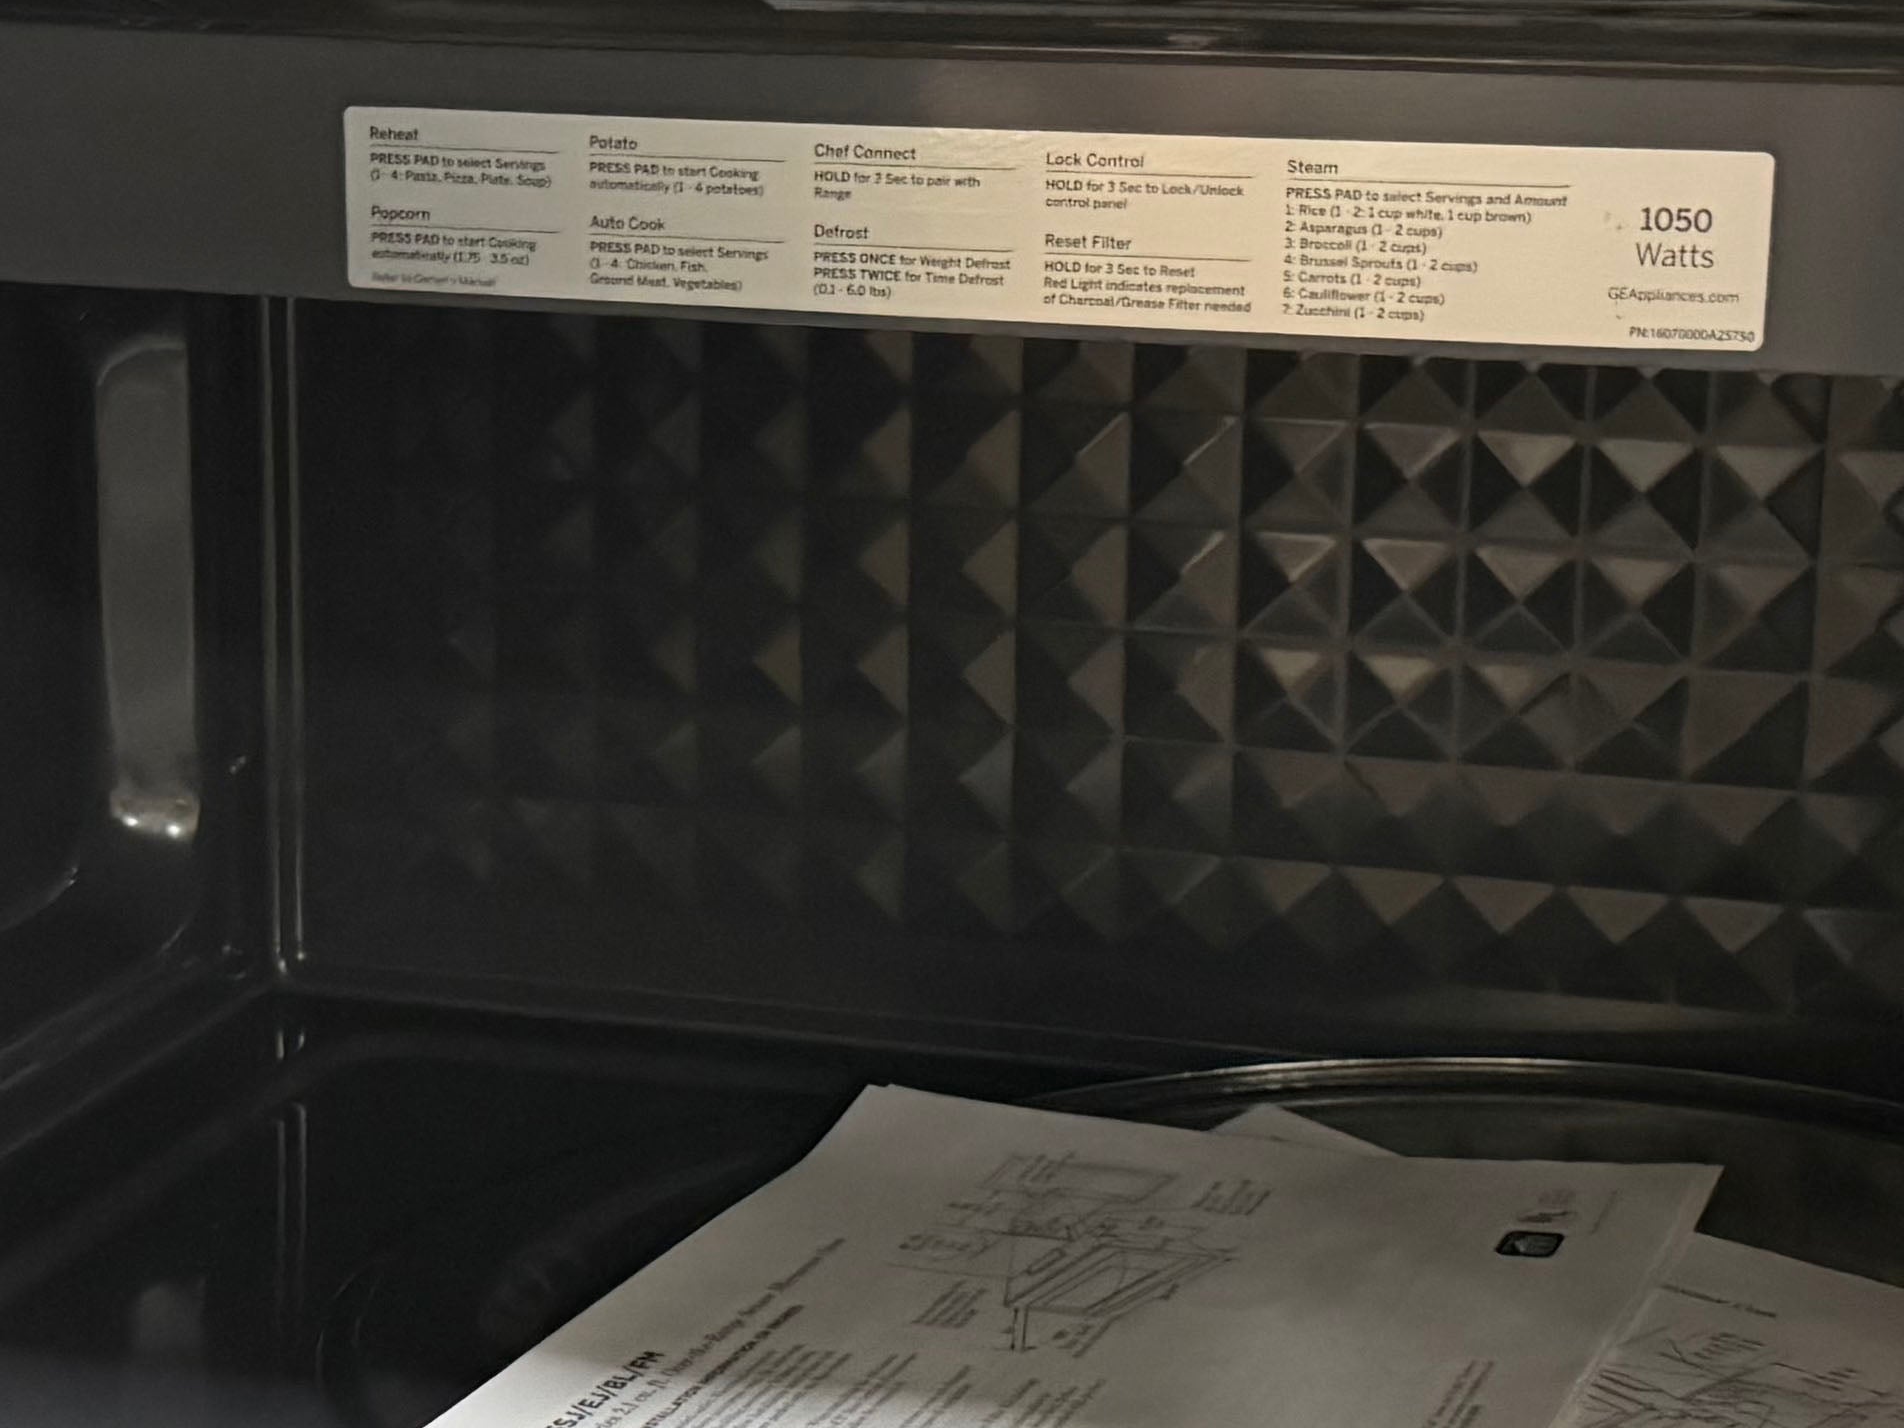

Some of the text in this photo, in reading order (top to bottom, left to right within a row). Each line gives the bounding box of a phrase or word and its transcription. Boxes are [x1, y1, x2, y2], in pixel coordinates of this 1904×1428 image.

[370, 126, 418, 140] Reheat
[590, 135, 638, 150] Potato
[815, 143, 916, 160] Chef Connect
[370, 153, 545, 171] PRESS PAD to select Servings
[1046, 152, 1144, 168] Lock Control
[1287, 160, 1338, 174] Steam
[589, 162, 759, 182] PRESS PAD to start Cooking
[814, 171, 980, 188] HOLD for Sec to pair with
[589, 179, 763, 197] automatically potatoes)
[815, 187, 851, 201] Range
[1046, 180, 1244, 196] HOLD for 3 Sec to Lock/Unlock
[1046, 197, 1127, 210] control panel
[1286, 188, 1567, 207] PRESS PAD to select Servings and Amount
[371, 205, 430, 221] Popcorn
[1299, 206, 1531, 224] Rice cup cup brown)
[1640, 207, 1712, 233] 1050
[589, 216, 665, 231] Auto Cook
[1299, 222, 1443, 238] Asparagus cups)
[814, 224, 869, 240] Defrost
[372, 232, 537, 251] PRESS PAD to start Cooking
[1046, 234, 1132, 250] Reset Filter
[1299, 239, 1352, 251] Broccoli
[590, 241, 769, 261] PRESS PAD to select Servings
[1636, 242, 1714, 268] Watts
[814, 251, 1010, 270] PRESS ONCE for Weight Defrost
[1352, 256, 1402, 271] Sprouts
[814, 267, 1004, 286] PRESS TWICE for Time Defrost
[1045, 261, 1195, 277] HOLD for 3 Sec to Reset
[1044, 277, 1245, 297] Red Light indicates replacement
[1298, 273, 1421, 288] Carrots cups)
[1298, 289, 1445, 305] Cauliflower cups)
[1608, 287, 1739, 303] GEAppliances.com
[1043, 294, 1251, 313] of Filter needed
[1388, 310, 1424, 321] cups)
